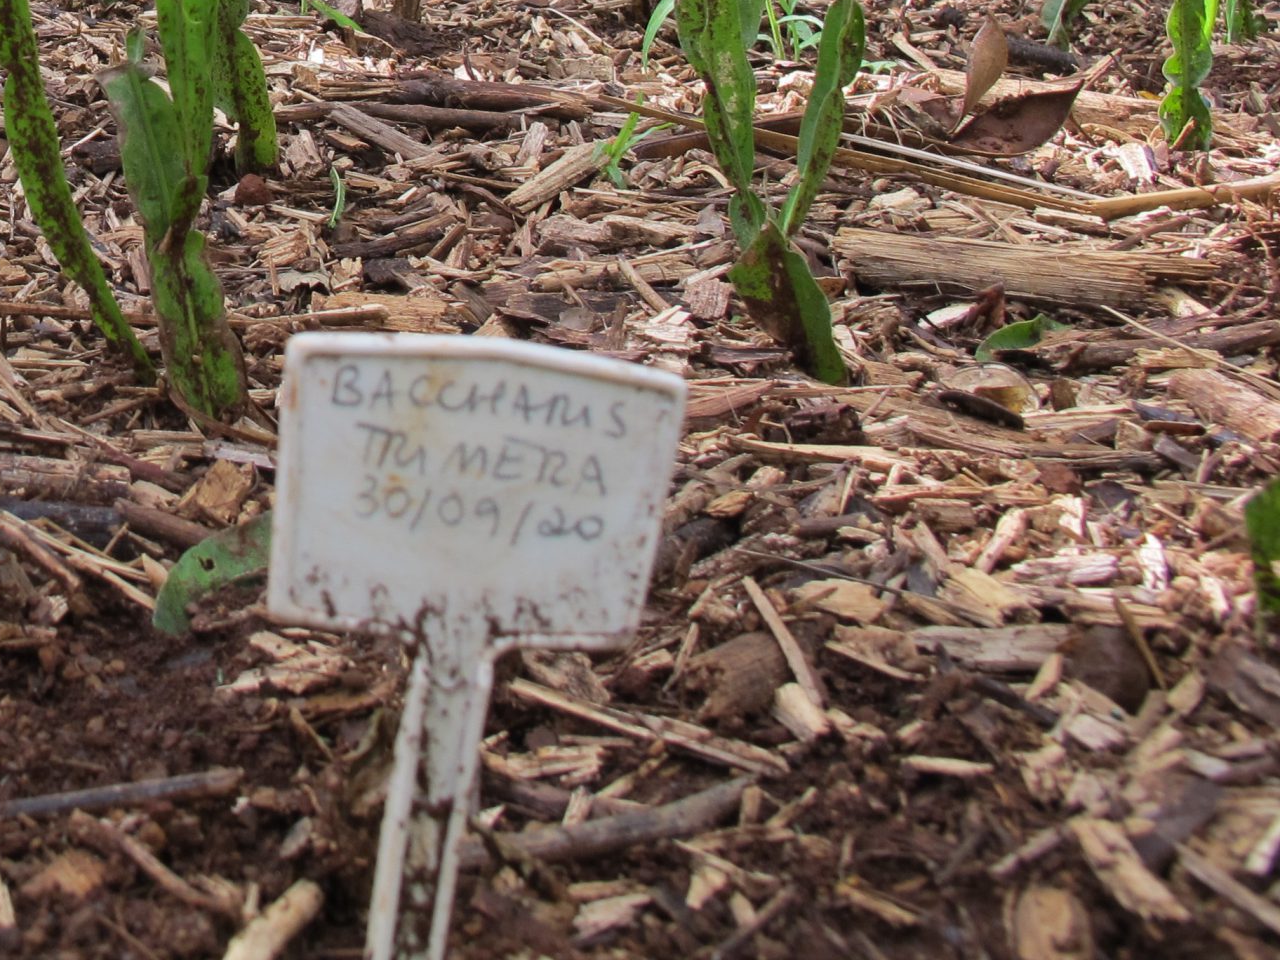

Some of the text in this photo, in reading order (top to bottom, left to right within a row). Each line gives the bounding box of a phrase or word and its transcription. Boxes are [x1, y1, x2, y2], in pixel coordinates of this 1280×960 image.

[331, 363, 628, 439] BACCHARIS
[355, 421, 608, 496] TRIMERA
[354, 474, 606, 547] 30/09/20
